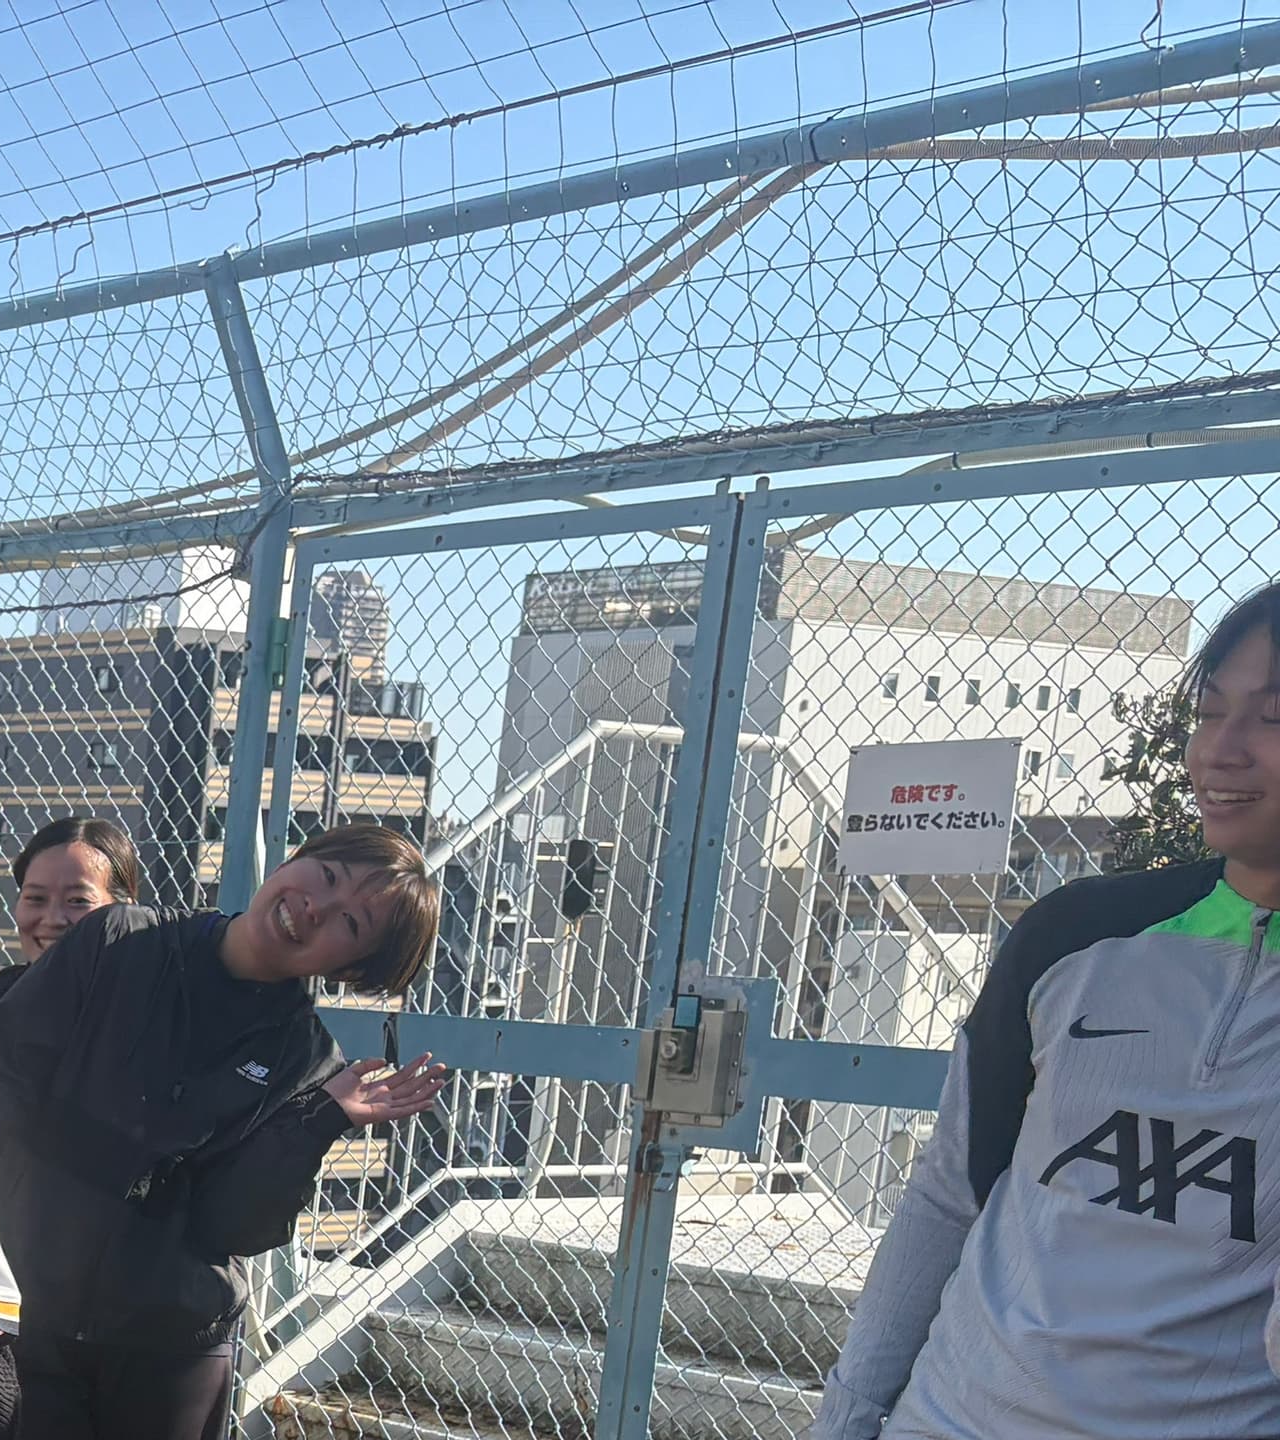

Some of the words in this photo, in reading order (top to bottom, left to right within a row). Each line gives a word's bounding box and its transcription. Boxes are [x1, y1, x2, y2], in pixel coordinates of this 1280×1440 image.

[891, 784, 965, 804] 危険です。
[846, 811, 1005, 833] 登らないでください。
[1038, 1110, 1256, 1243] AXA
